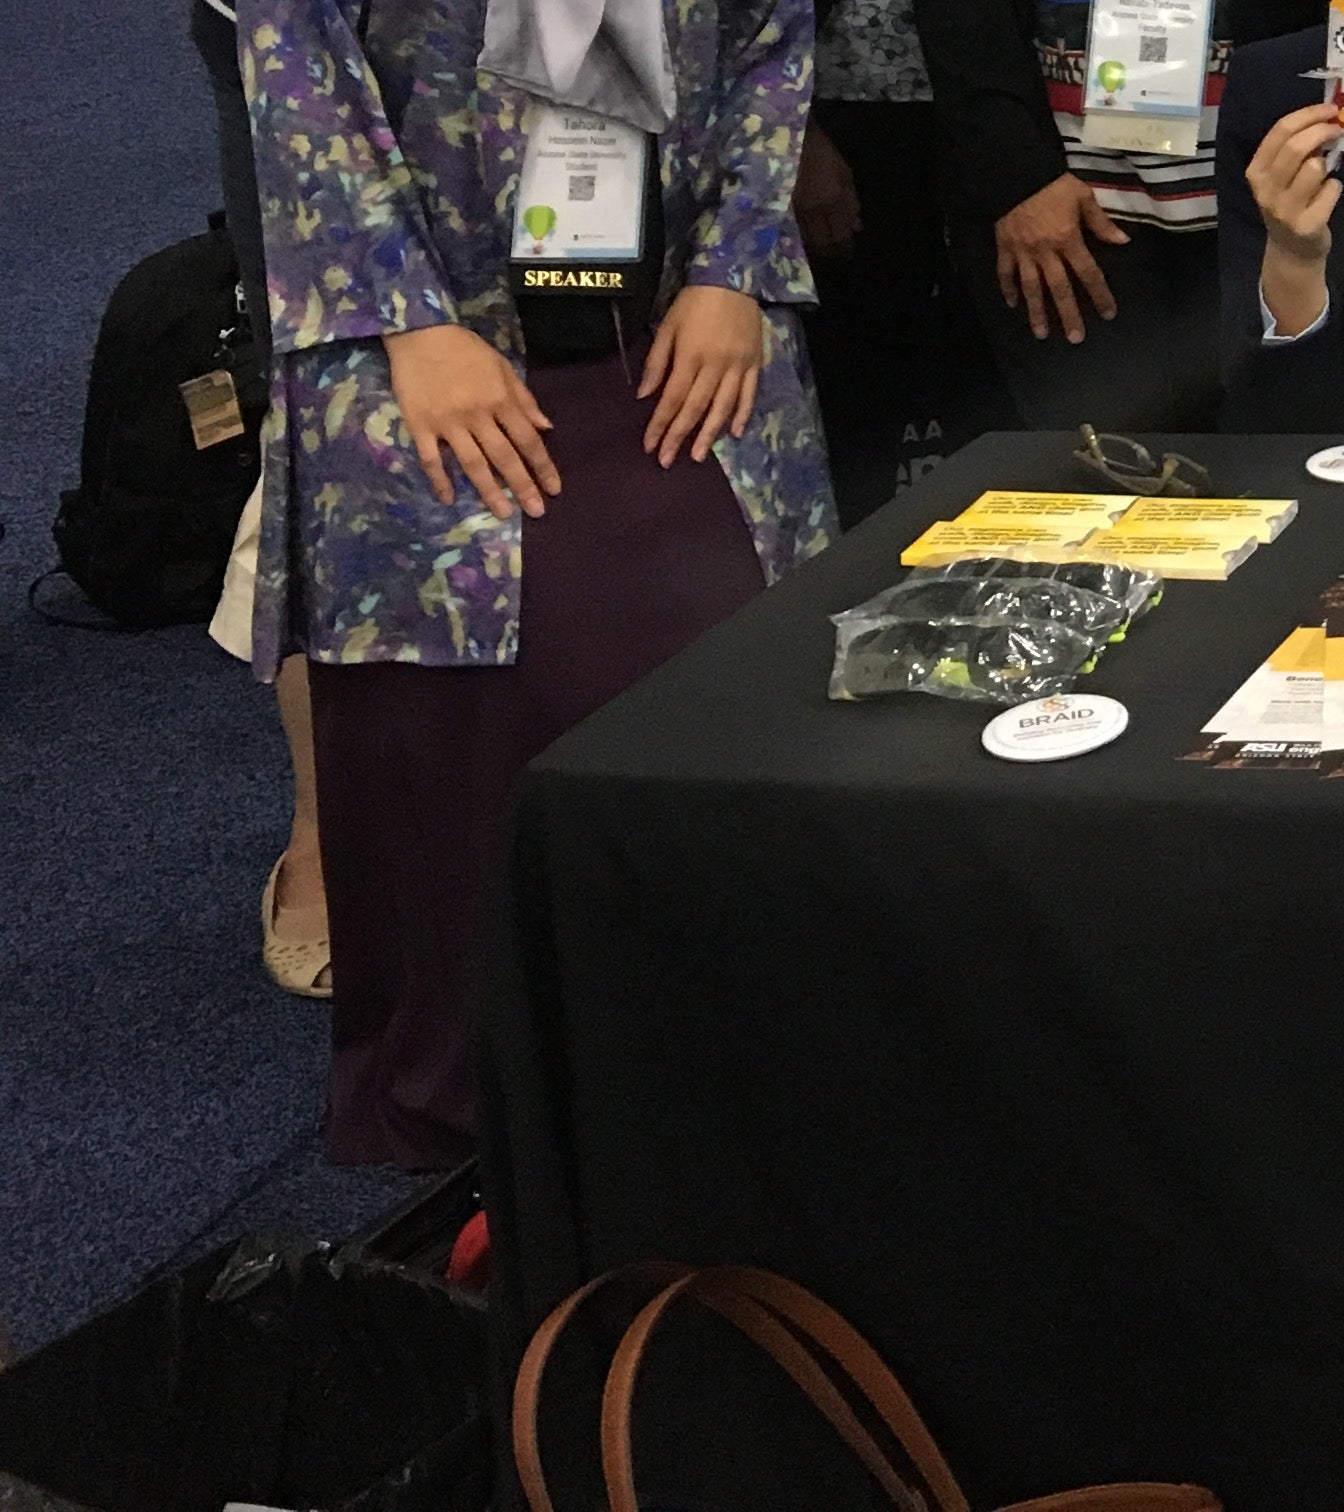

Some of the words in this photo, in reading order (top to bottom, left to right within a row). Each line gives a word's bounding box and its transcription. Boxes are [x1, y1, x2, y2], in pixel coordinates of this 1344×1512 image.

[524, 270, 623, 288] SPEAKER
[1018, 709, 1095, 729] BRAID
[1240, 743, 1286, 753] ASU
